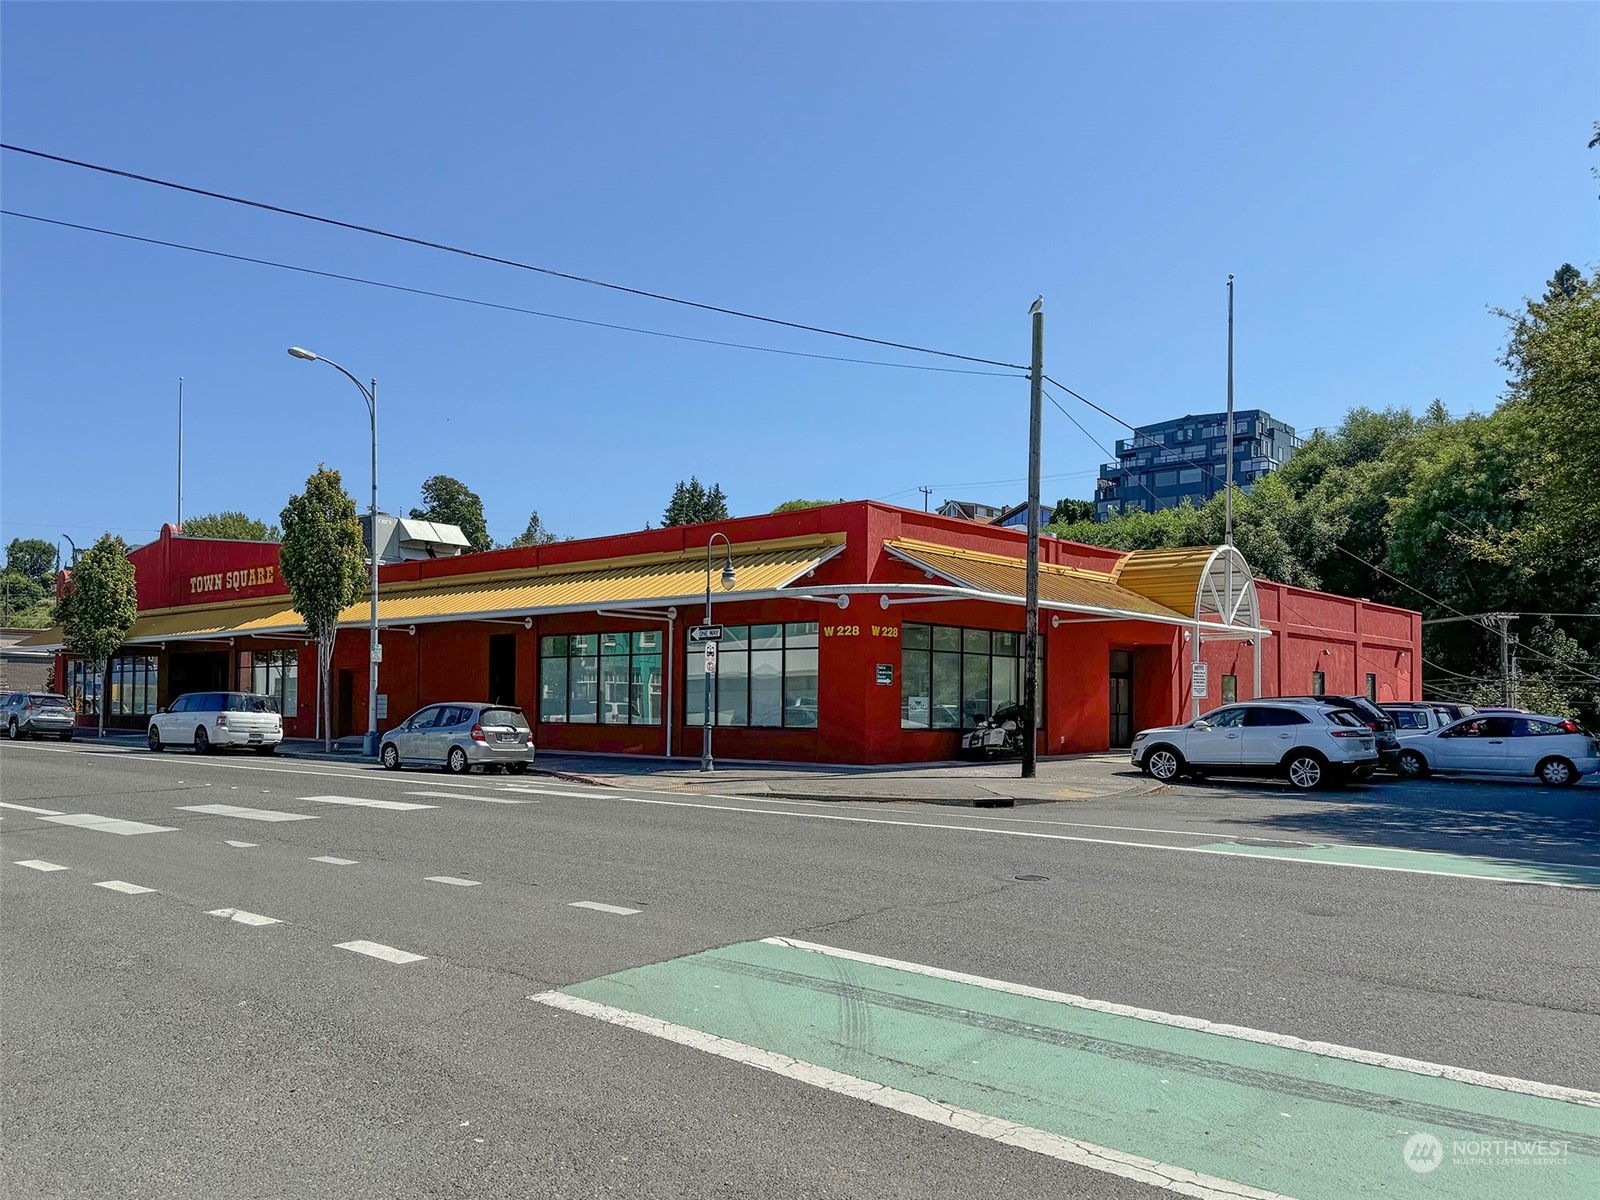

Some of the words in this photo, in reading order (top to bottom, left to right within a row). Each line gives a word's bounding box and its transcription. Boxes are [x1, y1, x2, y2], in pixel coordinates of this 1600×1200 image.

[190, 574, 223, 593] TOWN
[226, 566, 274, 591] SQUARE
[824, 626, 834, 637] W
[836, 625, 860, 636] 228
[871, 625, 880, 636] W
[881, 626, 898, 638] 228
